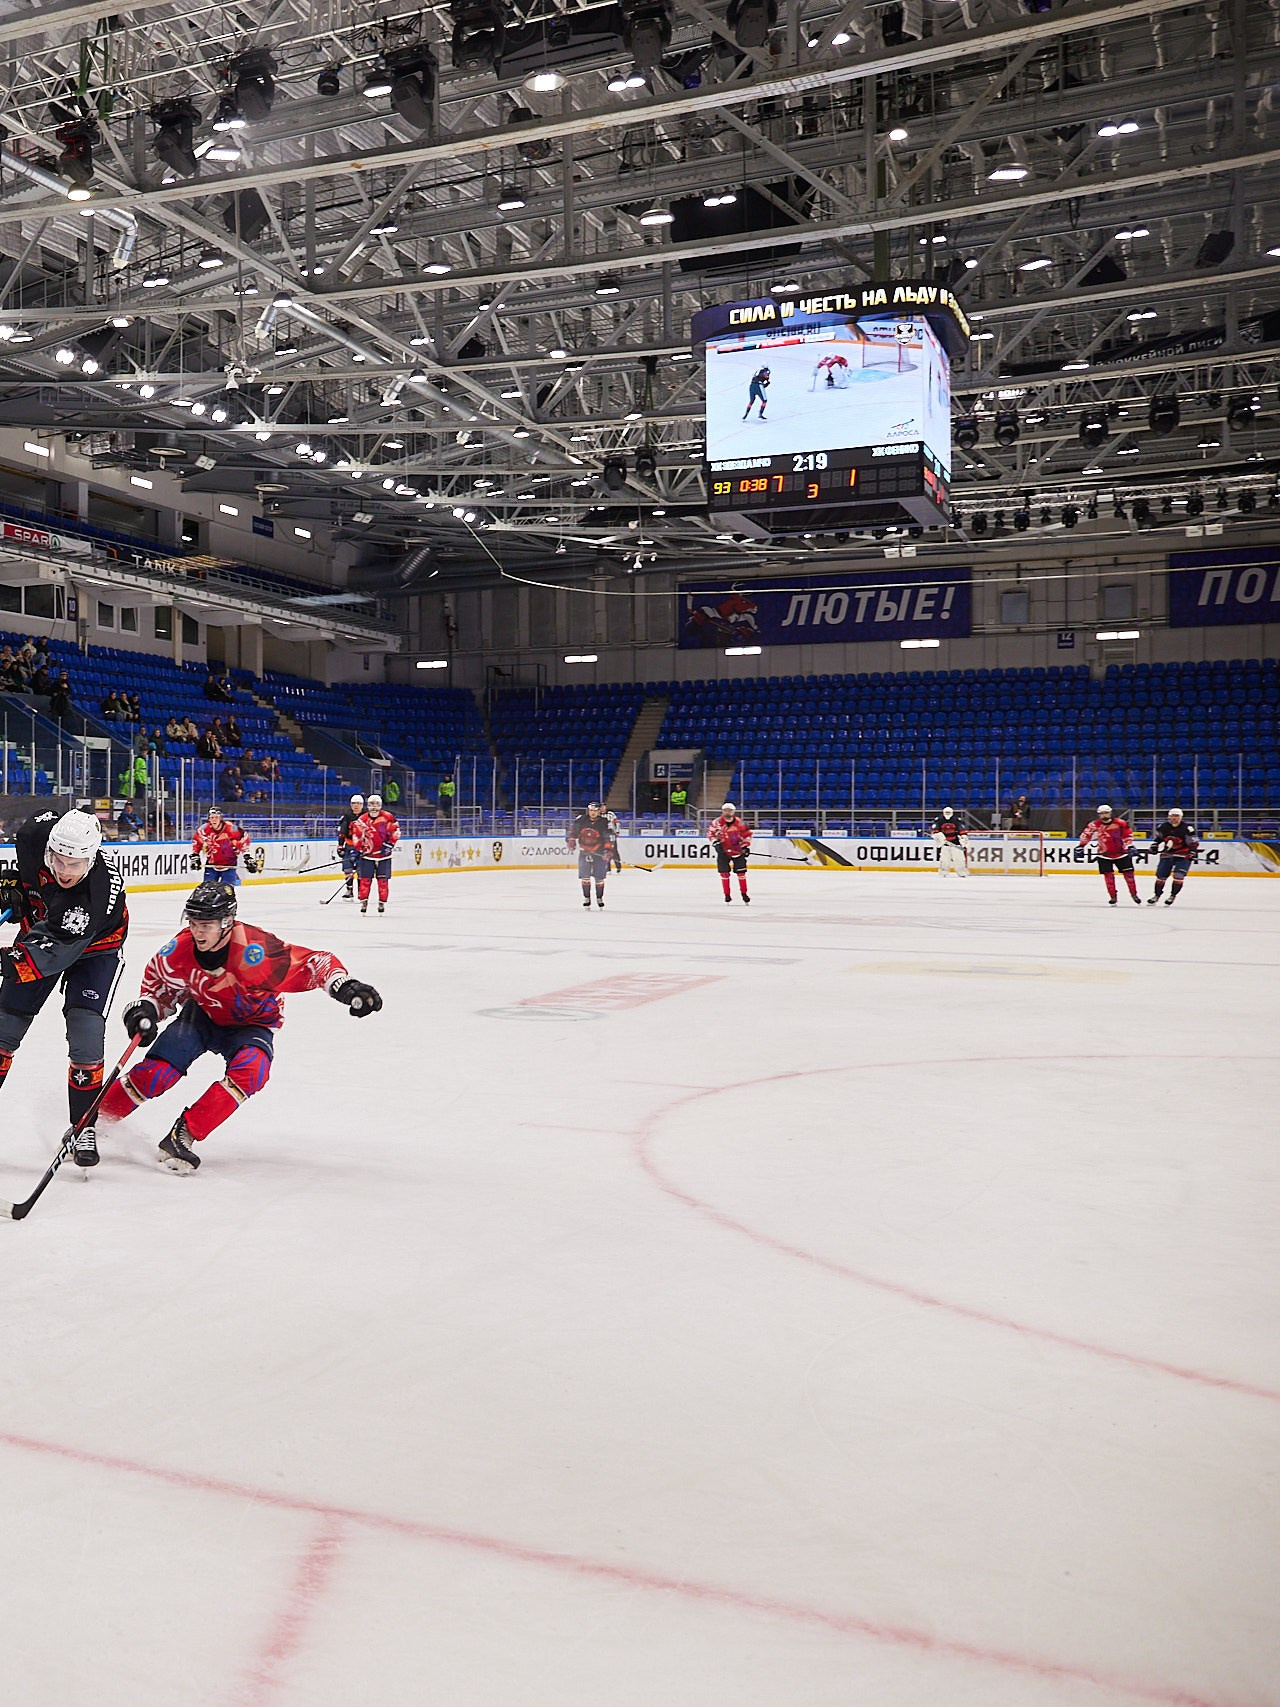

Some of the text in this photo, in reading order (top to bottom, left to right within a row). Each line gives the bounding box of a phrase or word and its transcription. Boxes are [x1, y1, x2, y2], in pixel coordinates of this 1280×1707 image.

[729, 286, 937, 325] СИЛА И ЧЕСТЬ НА ЛЬДУ
[1188, 337, 1223, 351] ЛИГИ
[792, 452, 828, 472] 2:19
[713, 481, 732, 495] 93
[739, 478, 768, 493] 0:38
[773, 475, 784, 493] 7
[807, 484, 819, 499] 3
[14, 528, 50, 546] SPAR
[131, 554, 177, 577] TANK
[1197, 567, 1280, 606] ПО
[781, 586, 956, 627] ЛЮТЫЕ!
[154, 854, 188, 875] ЛИГА
